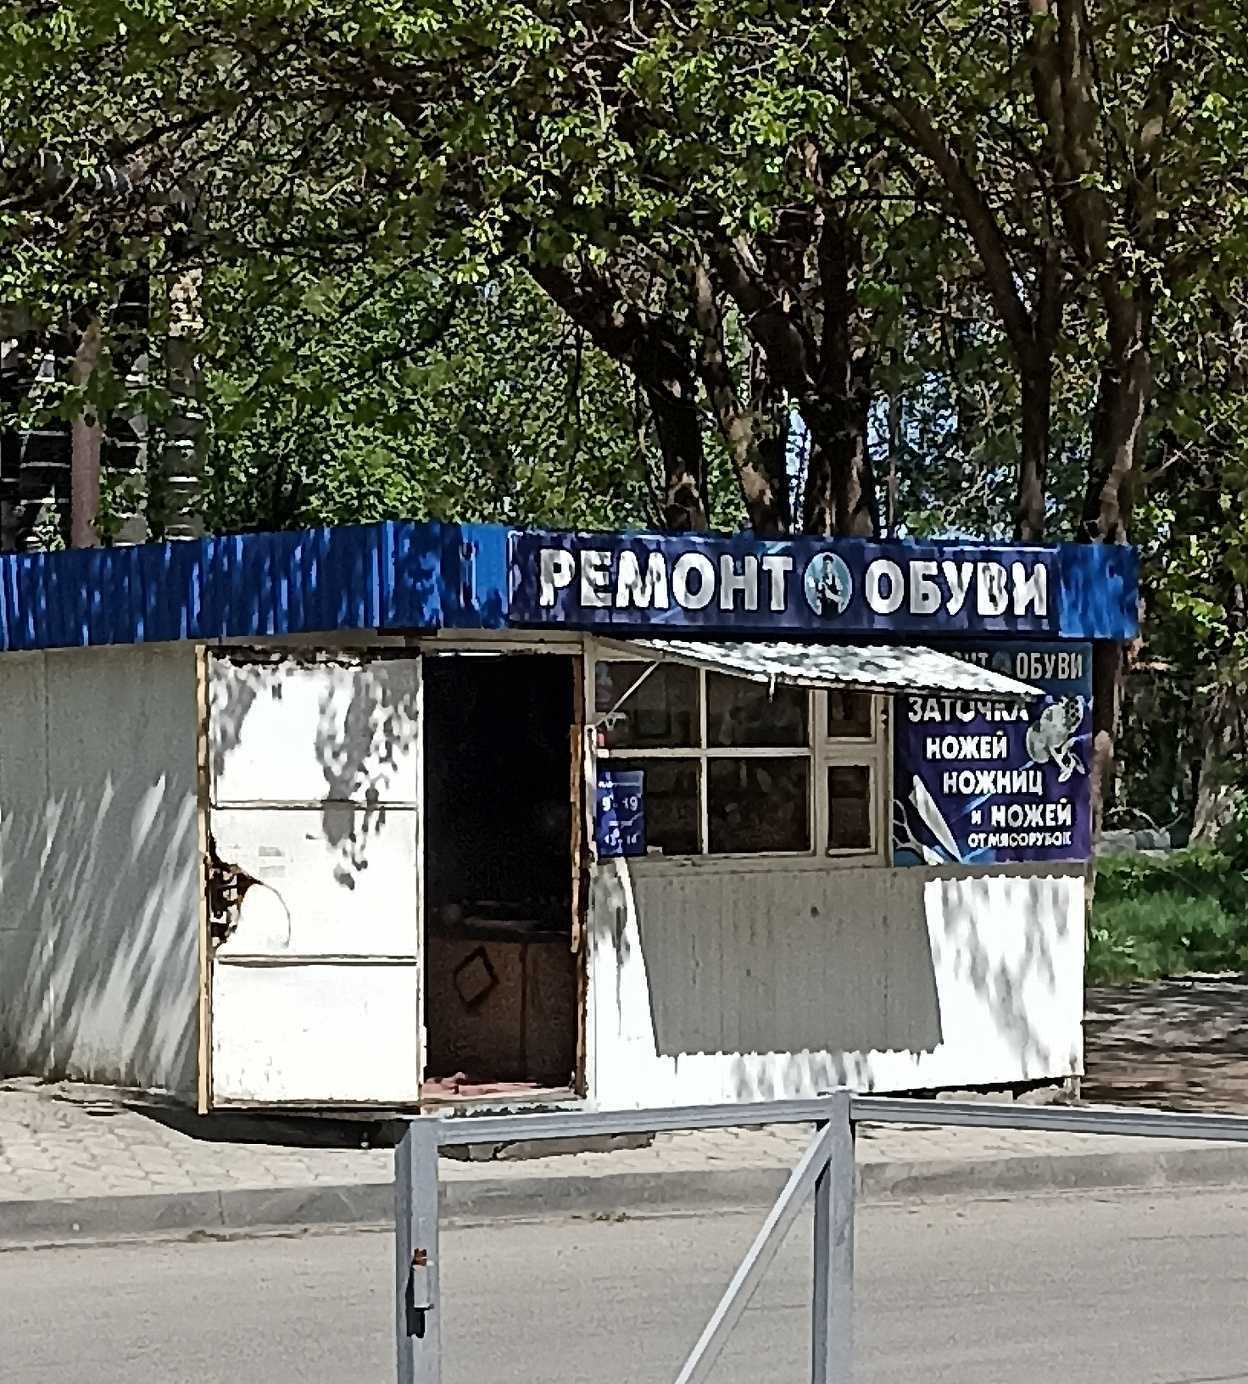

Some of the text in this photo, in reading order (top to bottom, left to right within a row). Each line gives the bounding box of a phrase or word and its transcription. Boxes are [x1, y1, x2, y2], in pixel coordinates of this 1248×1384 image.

[538, 548, 1048, 616] РЕМОНТ ОБУВИ
[1015, 652, 1083, 680] ОБУВИ
[926, 731, 1007, 760] НОЖЕЙ
[943, 770, 1043, 796] НОЖНИЦ
[990, 798, 1072, 828] НОЖЕЙ
